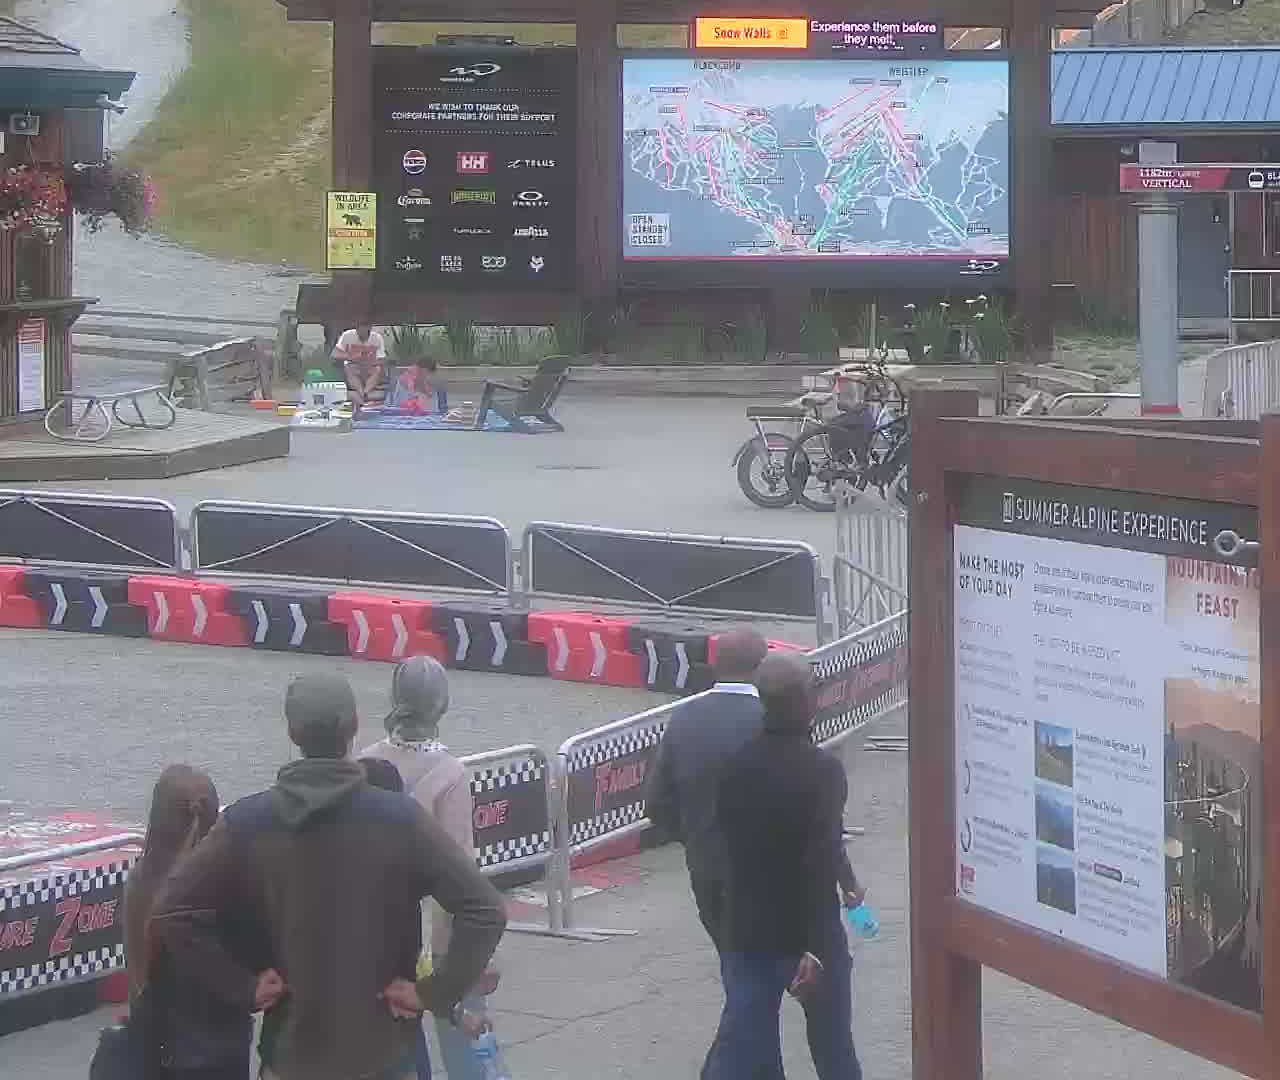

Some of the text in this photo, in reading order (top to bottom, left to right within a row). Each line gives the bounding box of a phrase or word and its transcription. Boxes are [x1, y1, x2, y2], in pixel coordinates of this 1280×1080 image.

[810, 20, 936, 33] Experience them before
[844, 34, 868, 46] they
[1142, 179, 1192, 188] VERTICAL
[1015, 496, 1207, 545] SUMMER ALPINE EXPERIENCE
[959, 551, 1025, 578] MAKE THE MOST
[959, 574, 1013, 600] OF YOUR DAY
[1196, 593, 1240, 619] FEAST
[472, 798, 512, 831] ONE
[49, 895, 120, 954] ZONE
